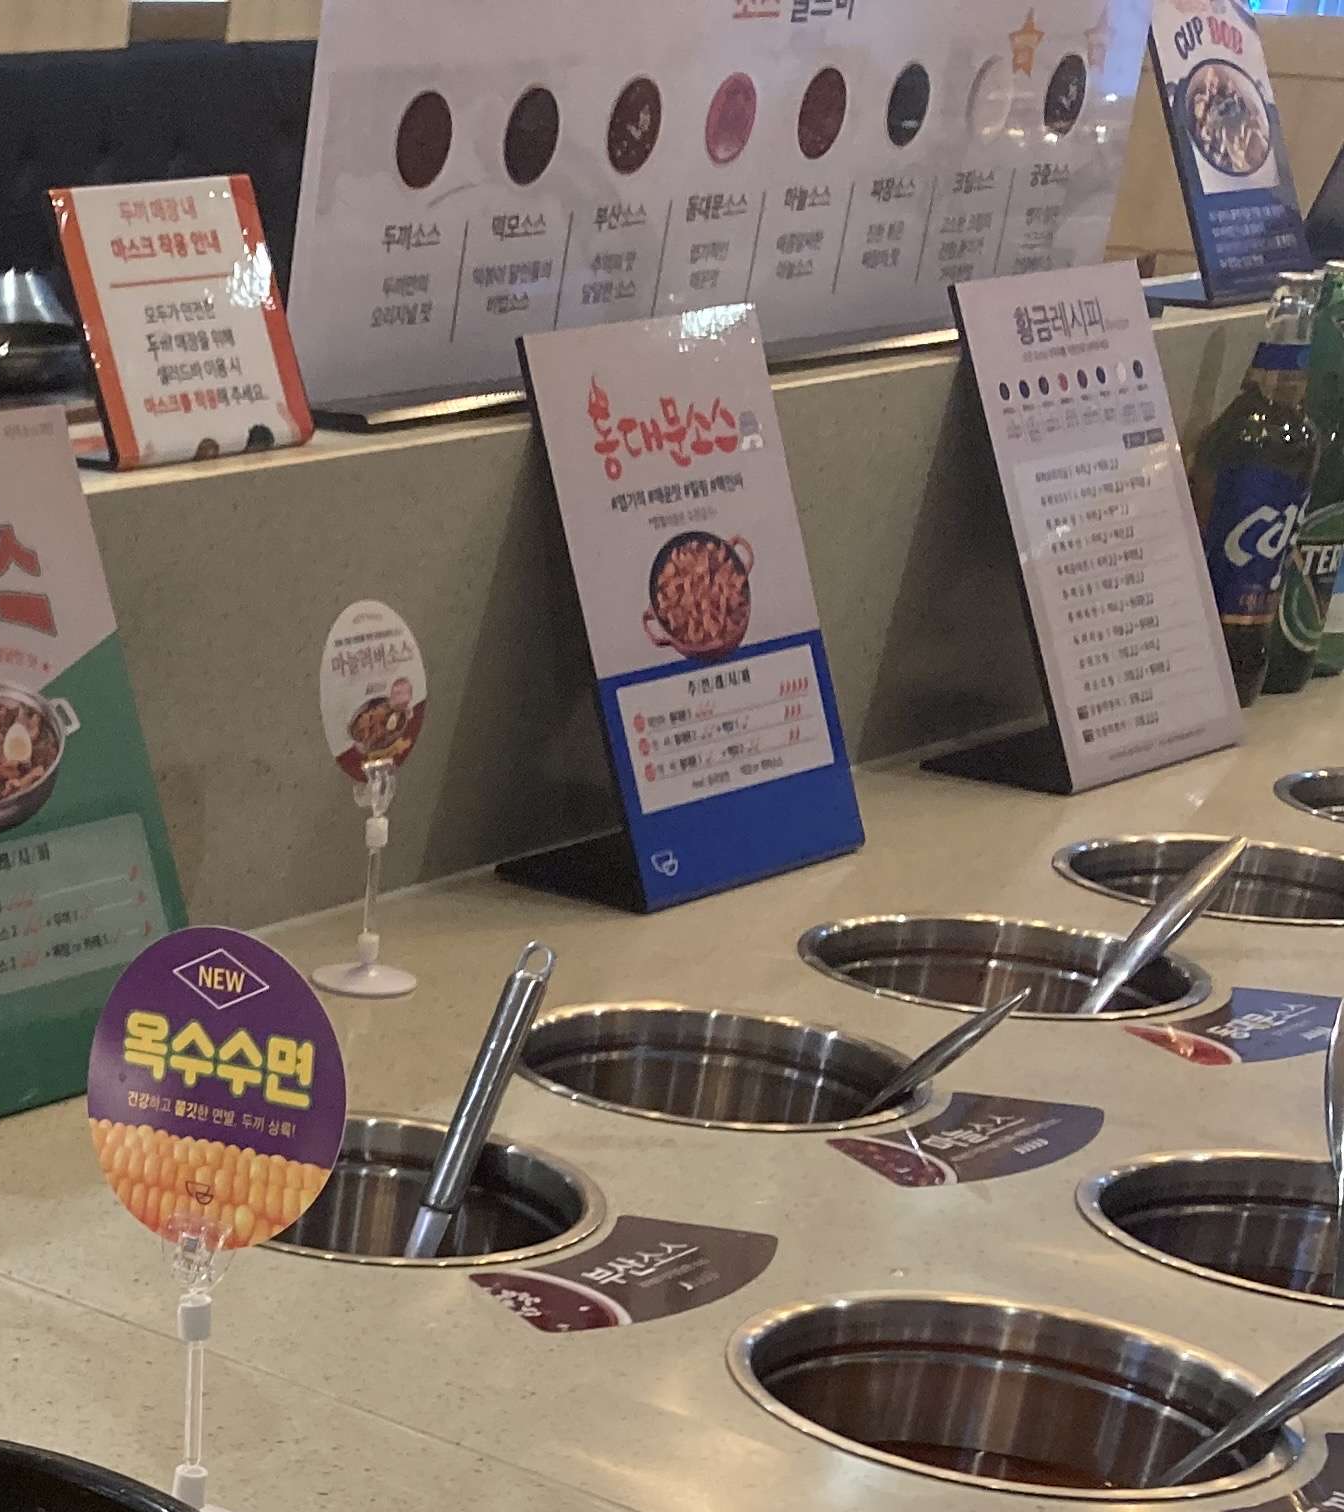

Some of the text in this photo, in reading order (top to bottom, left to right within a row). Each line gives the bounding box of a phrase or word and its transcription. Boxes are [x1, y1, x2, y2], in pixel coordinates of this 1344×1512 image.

[1174, 16, 1203, 60] CUP
[593, 203, 647, 232] 부산소스
[111, 236, 157, 263] 마스크
[191, 230, 222, 255] 안내
[1014, 297, 1106, 345] 황금레시피
[198, 964, 247, 993] NEW
[123, 1010, 315, 1110] 옥수수면
[128, 1089, 171, 1113] 건강하고
[242, 1112, 265, 1133] 두끼
[581, 1242, 699, 1286] 부산소스
